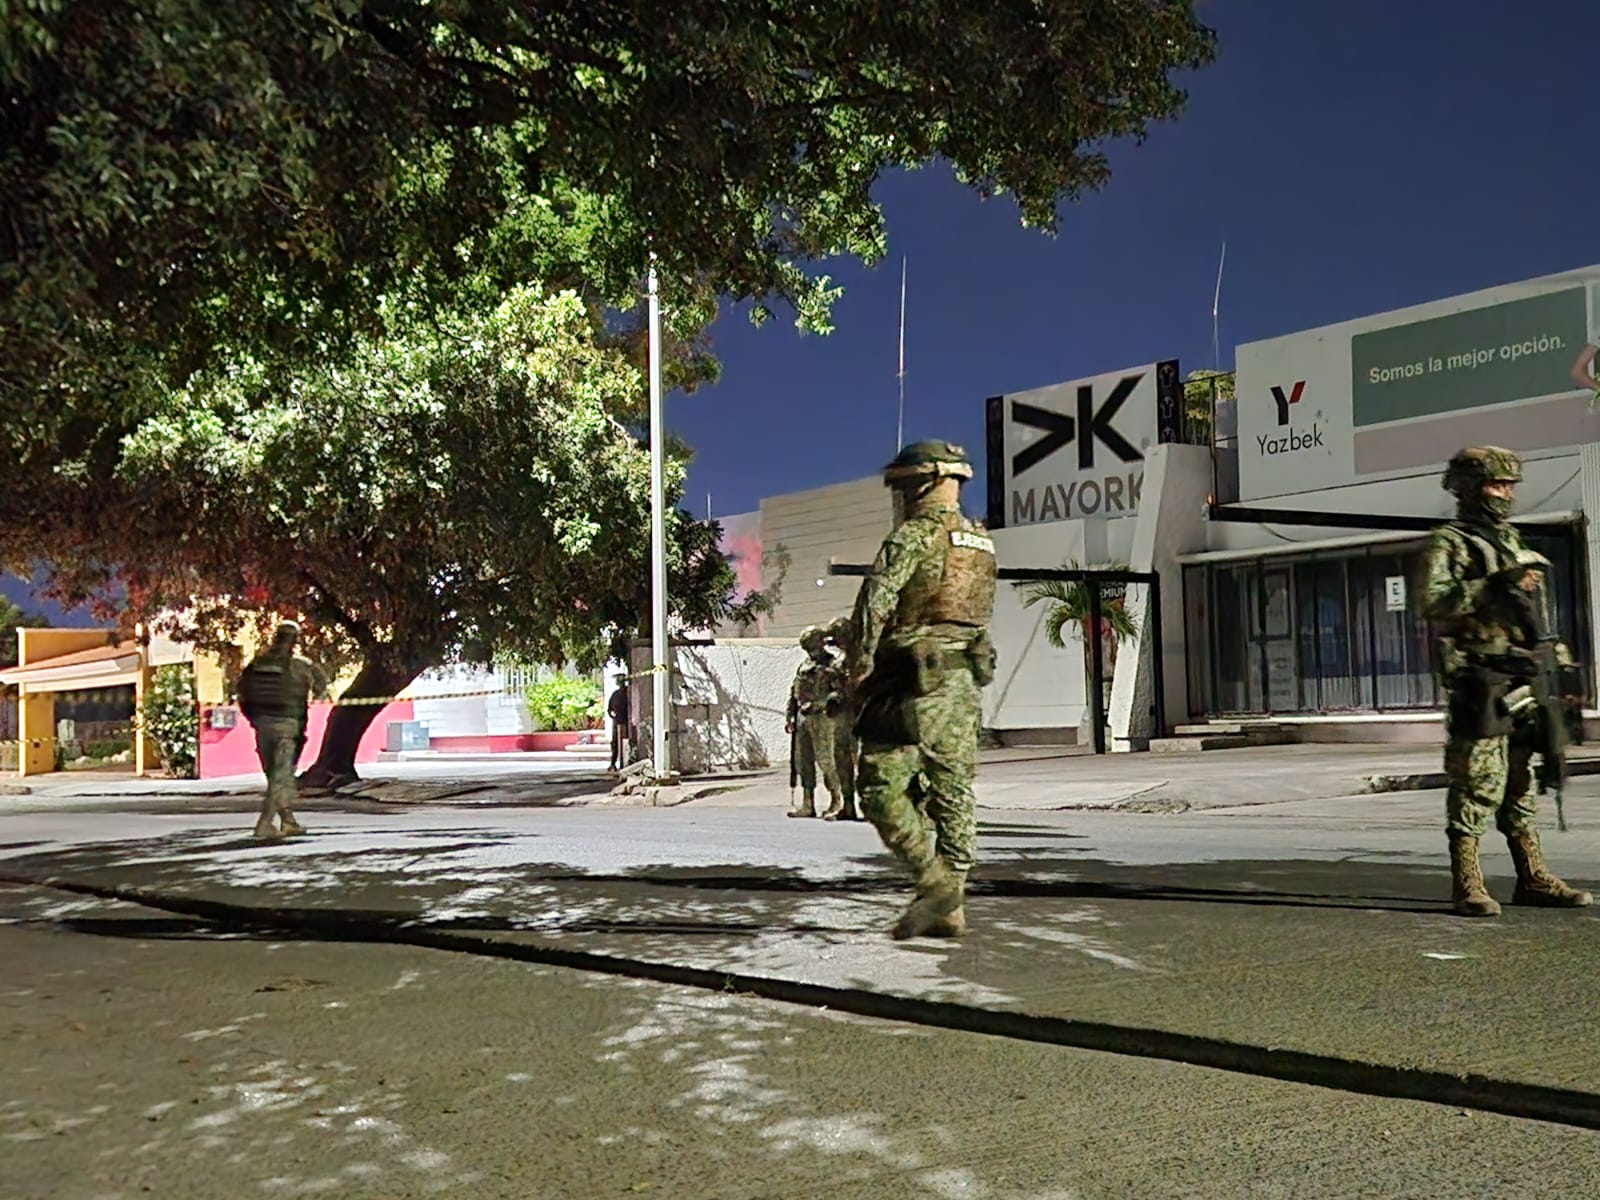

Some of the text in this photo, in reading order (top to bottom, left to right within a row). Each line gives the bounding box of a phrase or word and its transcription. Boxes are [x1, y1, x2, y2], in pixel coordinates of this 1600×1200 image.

[1369, 333, 1567, 384] Somos la mejor opción.
[1256, 423, 1324, 456] Yazbek
[1012, 472, 1144, 524] MAYORK
